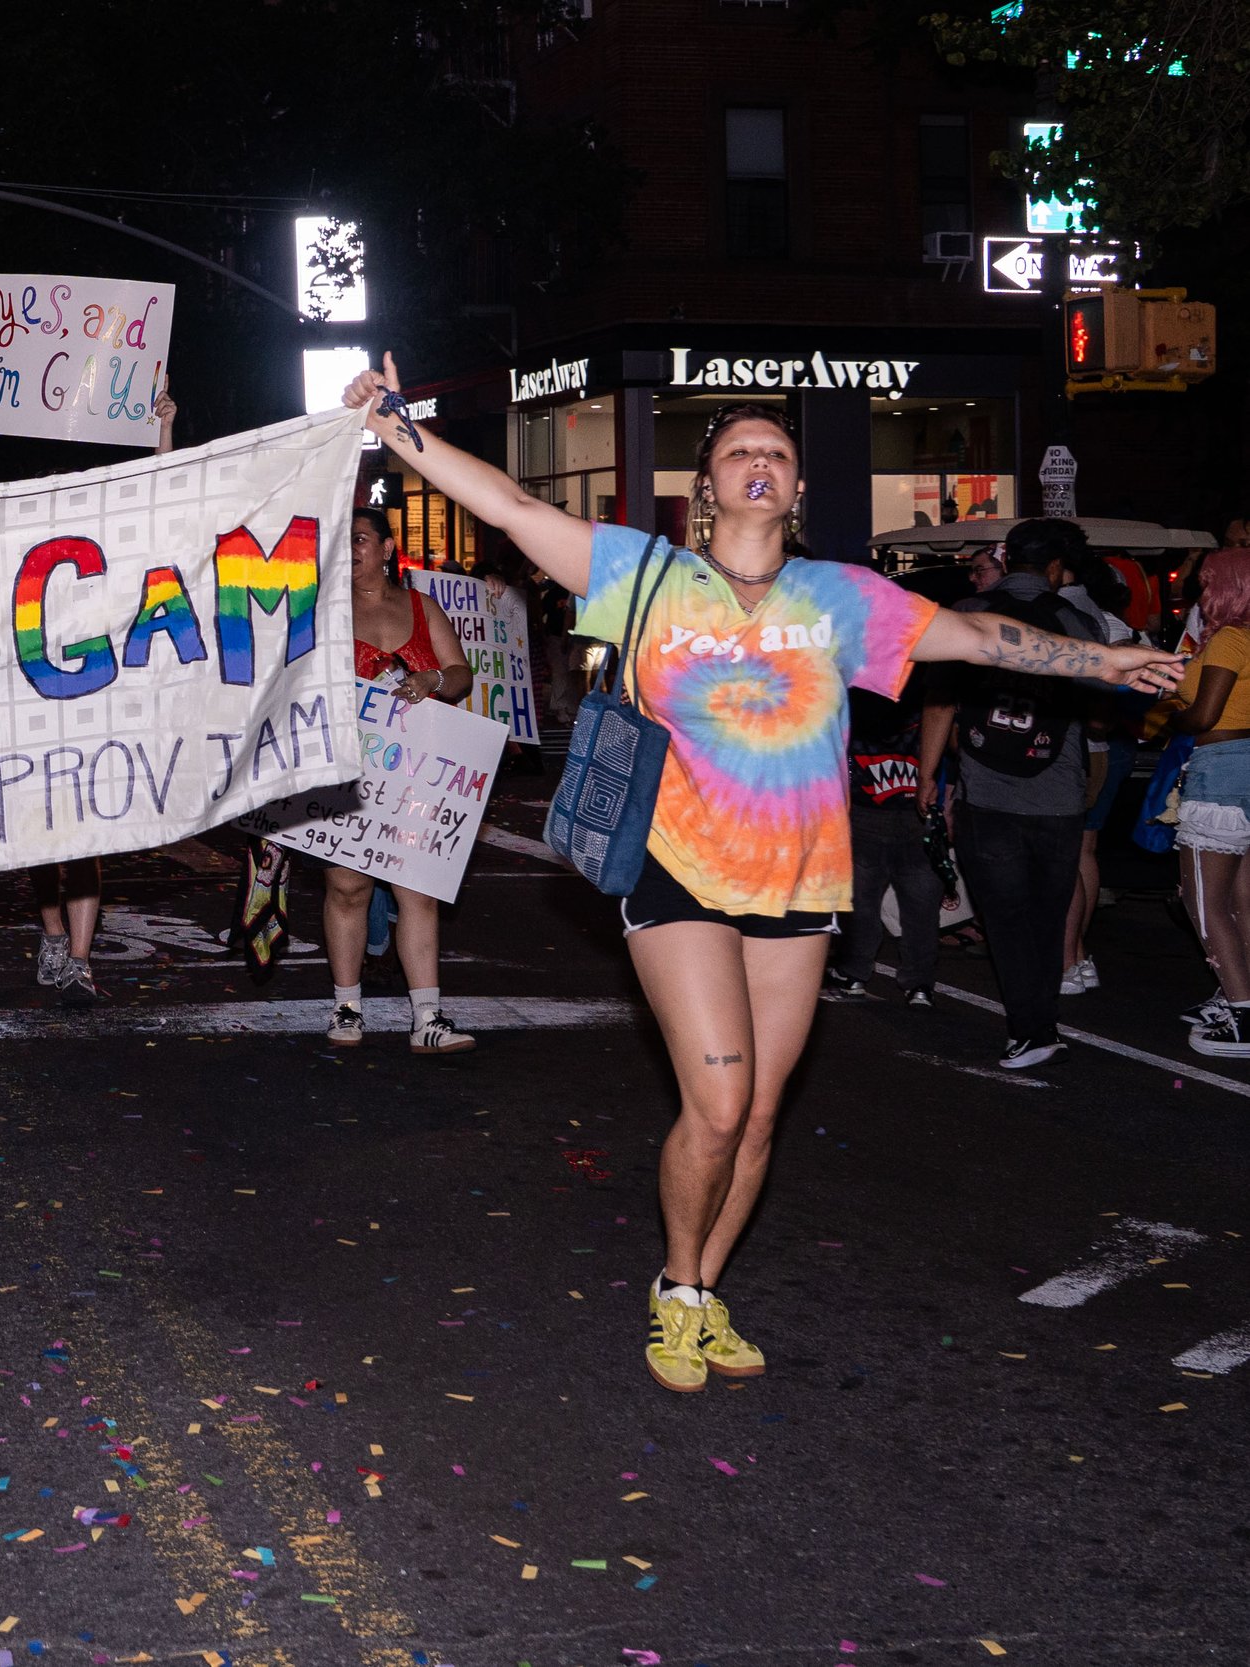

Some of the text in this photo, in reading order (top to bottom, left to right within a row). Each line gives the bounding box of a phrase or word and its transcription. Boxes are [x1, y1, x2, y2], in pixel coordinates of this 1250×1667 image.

[1015, 256, 1043, 275] ON
[83, 296, 158, 350] and
[509, 358, 590, 400] LaserAway
[670, 347, 921, 401] LaserAway
[400, 397, 437, 422] BRIDGE
[1050, 458, 1075, 466] KING
[1044, 510, 1073, 518] UCKS
[11, 514, 320, 701] GAM
[428, 577, 479, 612] AUGH
[452, 616, 486, 642] UGH
[659, 613, 833, 664] yes, and
[467, 648, 506, 680] UGH
[465, 682, 534, 739] UGH
[206, 694, 334, 802] JAM
[358, 731, 489, 802] ROV JAM
[306, 800, 372, 843] every
[391, 785, 468, 840] friday
